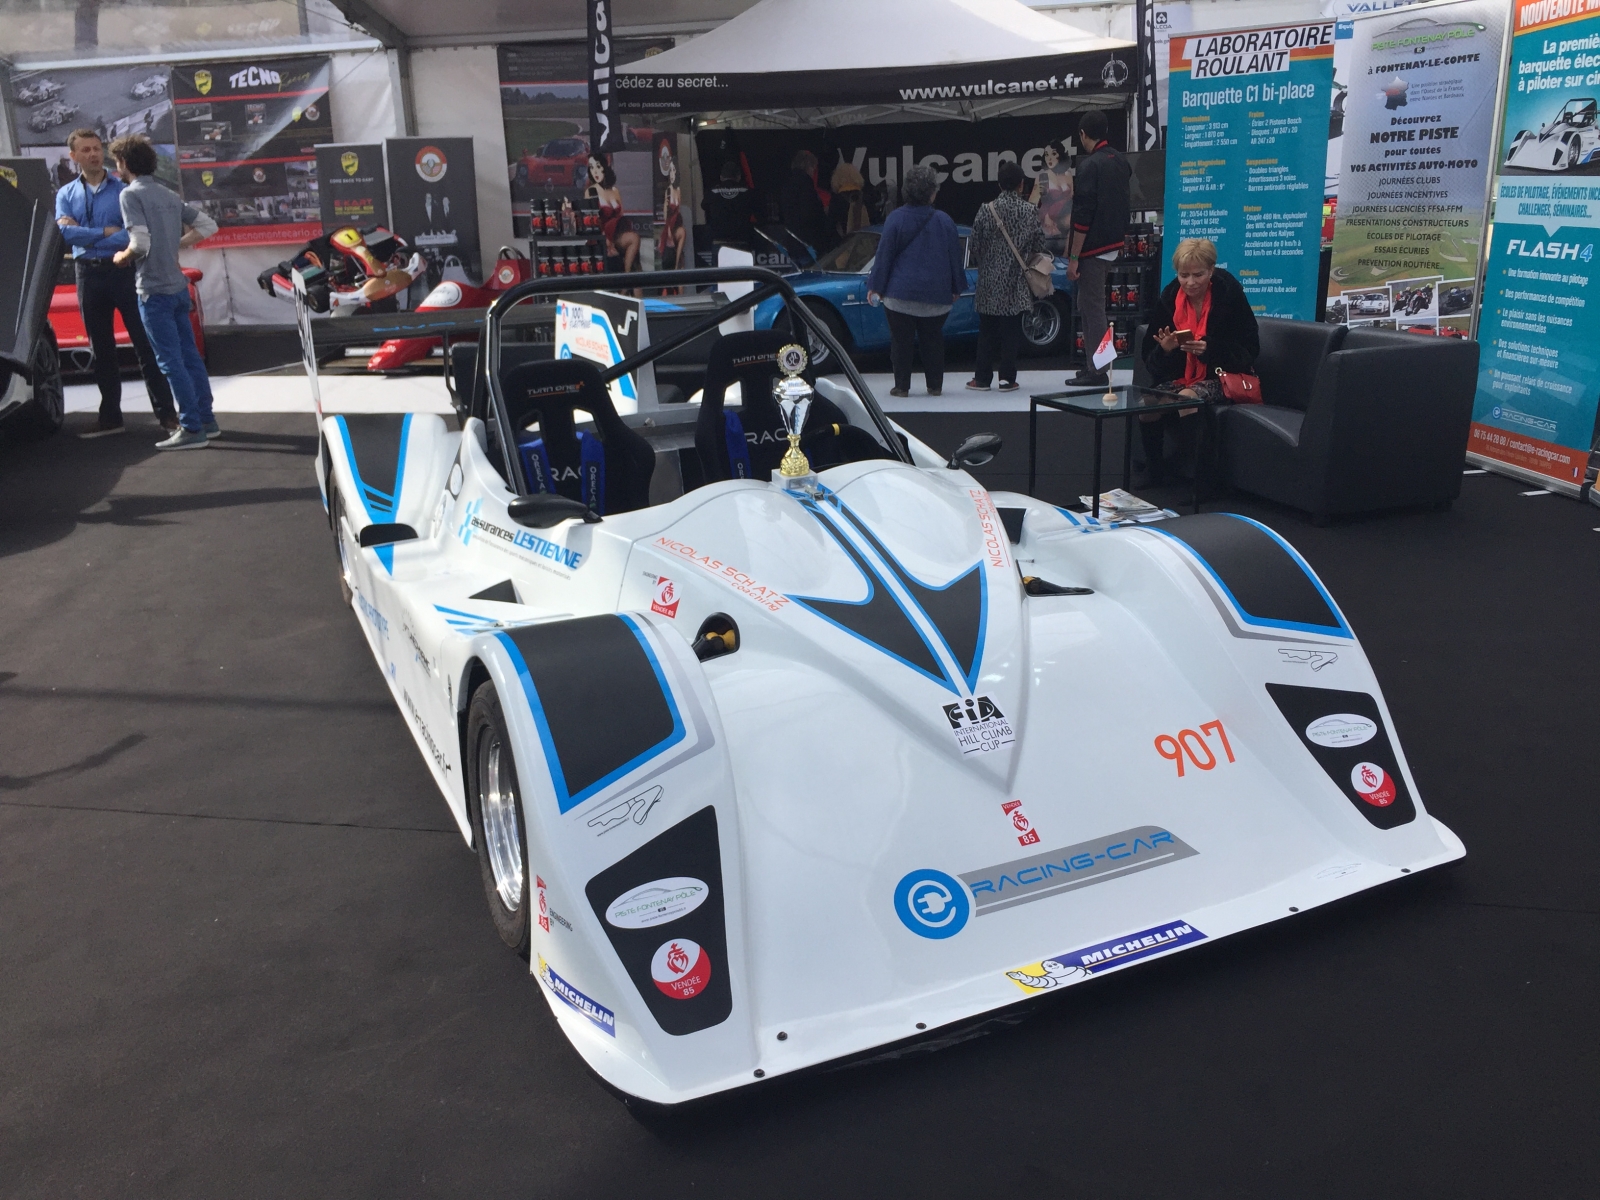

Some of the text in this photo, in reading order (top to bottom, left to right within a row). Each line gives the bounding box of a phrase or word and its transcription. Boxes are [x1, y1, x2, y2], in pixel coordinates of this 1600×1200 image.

[1195, 25, 1333, 57] LABORATOIRE
[1371, 40, 1396, 51] PISTE
[1397, 33, 1447, 47] FONTENAY
[1543, 33, 1600, 56] La premiè
[1195, 51, 1288, 78] ROULANT
[1368, 53, 1480, 75] à FONTENAY-LE-COMTE
[1519, 56, 1571, 75] barquette
[229, 66, 281, 88] TECNO
[657, 78, 673, 88] au
[677, 75, 728, 88] secret...
[1518, 77, 1525, 92] à
[1527, 75, 1562, 94] piloter
[1564, 75, 1584, 88] sur
[899, 73, 1083, 100] www.vulcanet.fr
[1182, 81, 1315, 110] Barquette C1 bi-place
[642, 100, 681, 109] passionnés
[1391, 115, 1441, 126] Découvrez
[1370, 127, 1459, 143] NOTRE PISTE
[1385, 147, 1441, 158] pour toutes
[1351, 159, 1478, 172] VOS ACTIVITÉS AUTO-MOTO
[1379, 176, 1441, 186] JOURNÉES CLUBS
[1367, 190, 1448, 200] JOURNÉES INCENTIVES
[1500, 183, 1517, 198] ÉCOLES
[1517, 186, 1524, 198] DE
[1552, 183, 1588, 200] ÉVÉNEMENTS
[1352, 204, 1463, 214] JOURNÉES LICENCIÉS FFSA-FFM
[1402, 219, 1469, 228] CONSTRUCTEURS
[1367, 232, 1442, 241] ÉCOLES DE PILOTAGE
[1374, 246, 1430, 255] ESSAIS ÉCURIES
[1358, 258, 1401, 267] PRÉVENTION
[1508, 268, 1517, 277] Une
[1517, 268, 1539, 279] formation
[1540, 270, 1561, 281] innovante
[1569, 274, 1589, 287] pilotage
[1505, 289, 1585, 307] Des performances de compétition
[1501, 320, 1547, 333] environnementales
[1509, 309, 1524, 319] plaisir
[1525, 312, 1537, 321] sans
[1538, 312, 1546, 322] les
[1546, 314, 1573, 326] nuisances
[1498, 339, 1558, 358] Des solutions techniques
[732, 355, 756, 364] TURN
[1503, 350, 1529, 363] financières
[1530, 356, 1559, 369] sur-mesure
[527, 383, 576, 395] TURN ONE
[1492, 381, 1504, 389] pour
[1522, 376, 1537, 387] relais
[1537, 378, 1544, 388] de
[1544, 381, 1573, 393] croissance
[1501, 411, 1557, 430] RACING-CAR
[531, 454, 546, 489] ORECA
[550, 466, 582, 481] RA
[589, 467, 597, 501] ORECA
[969, 489, 991, 521] SCHATZ
[471, 516, 515, 542] assurances
[513, 529, 582, 569] LESTIENNE
[981, 521, 1004, 568] NICOLAS
[655, 536, 790, 608] NICOLAS SCHATZ
[730, 582, 780, 611] coaching
[954, 719, 1009, 737] INTERNATIONAL
[958, 726, 1013, 747] HILL CLIMB
[980, 740, 1001, 752] CUP
[1154, 719, 1237, 777] 907
[1369, 790, 1391, 800] VENDÉE
[1023, 833, 1036, 844] 85
[969, 830, 1175, 898] RACING-CAR
[614, 907, 637, 919] PISTE
[636, 896, 674, 912] FONTENAY
[675, 890, 696, 901] PÔLE
[1080, 924, 1193, 965] MICHELIN
[671, 976, 702, 992] VENDÉE
[683, 987, 695, 997] 85
[555, 978, 614, 1027] MICHELIN
